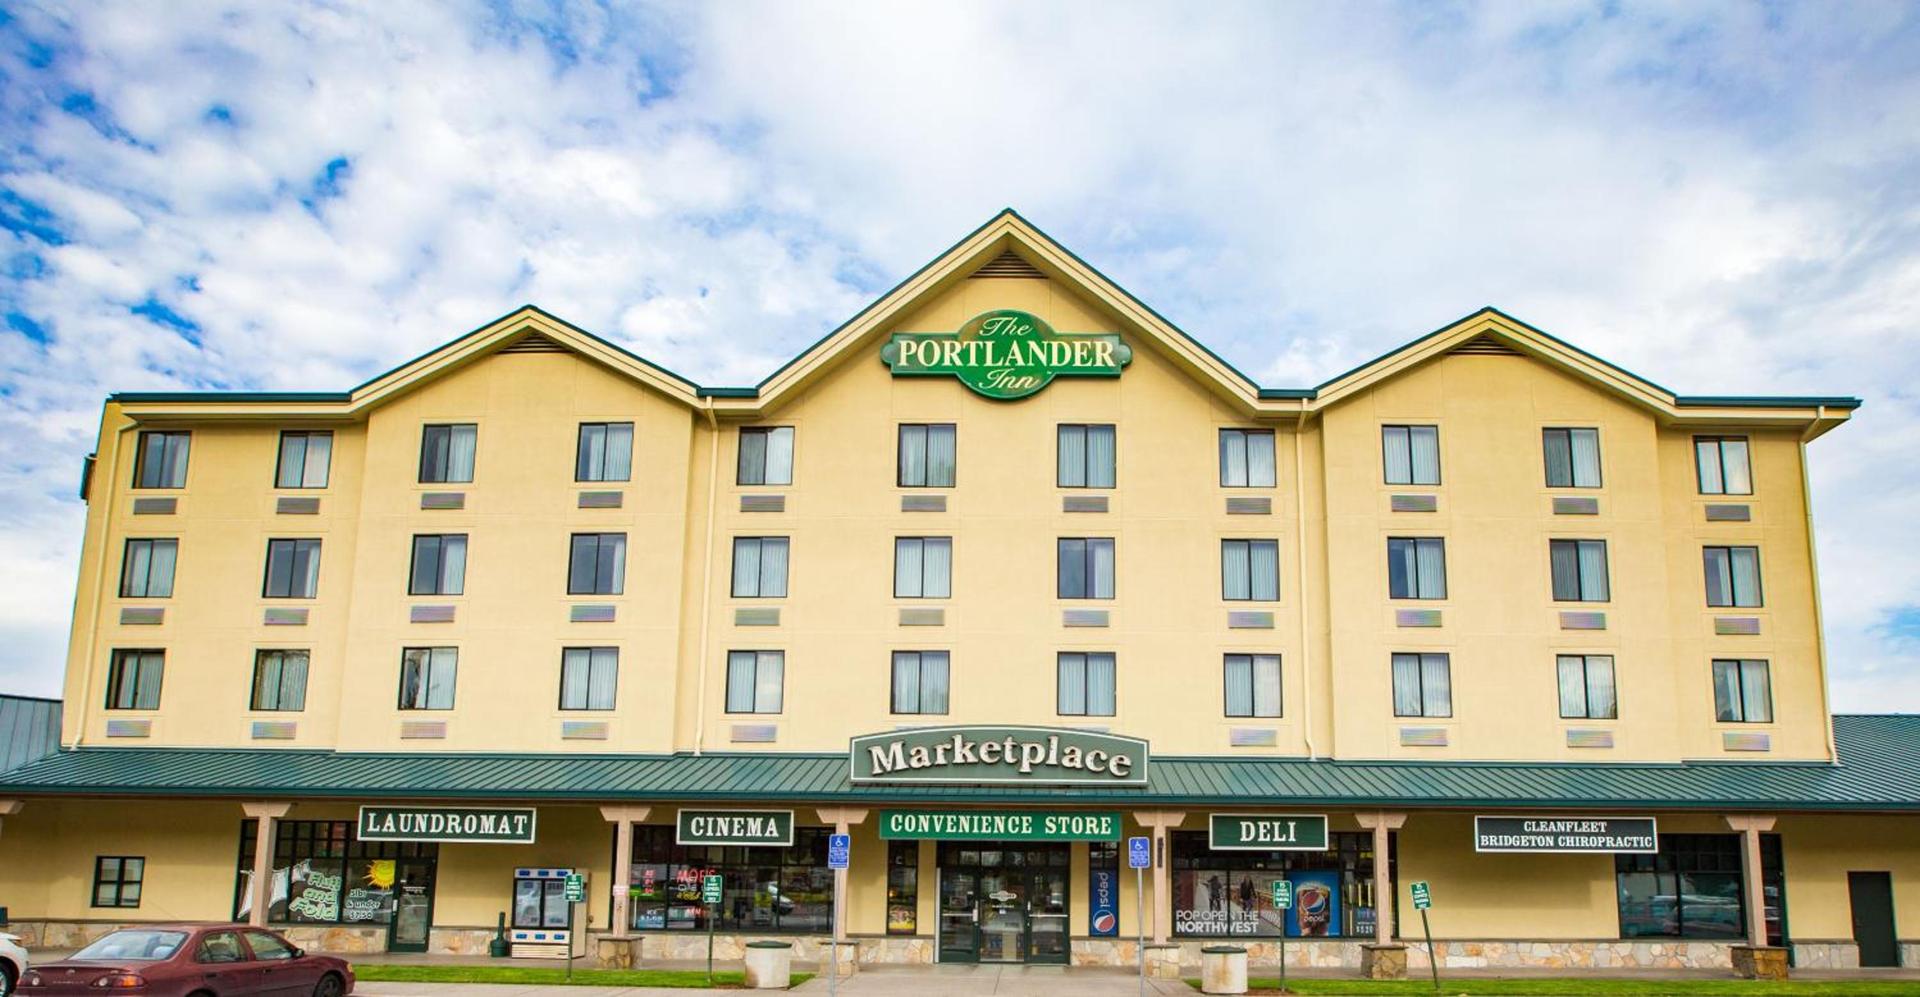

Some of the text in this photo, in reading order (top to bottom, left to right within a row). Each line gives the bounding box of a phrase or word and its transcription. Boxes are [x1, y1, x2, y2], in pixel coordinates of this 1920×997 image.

[979, 316, 1033, 337] The
[898, 339, 1116, 368] PORTLANDER
[978, 368, 1041, 389] Inn
[868, 734, 1132, 777] Marketplace
[366, 812, 528, 835] LAUNDROMAT
[690, 816, 779, 837] CINEMA
[890, 813, 1112, 835] CONVENIENCE STORE
[1239, 821, 1296, 842] DELI
[1523, 821, 1607, 833] CLEANFLEET
[1480, 835, 1653, 848] BRIDGETON CHIROPRACTIC
[1097, 872, 1110, 908] pepsi
[289, 896, 338, 921] Fold
[1176, 910, 1259, 921] POP OPEN THE
[1176, 921, 1259, 933] NORTHWEST
